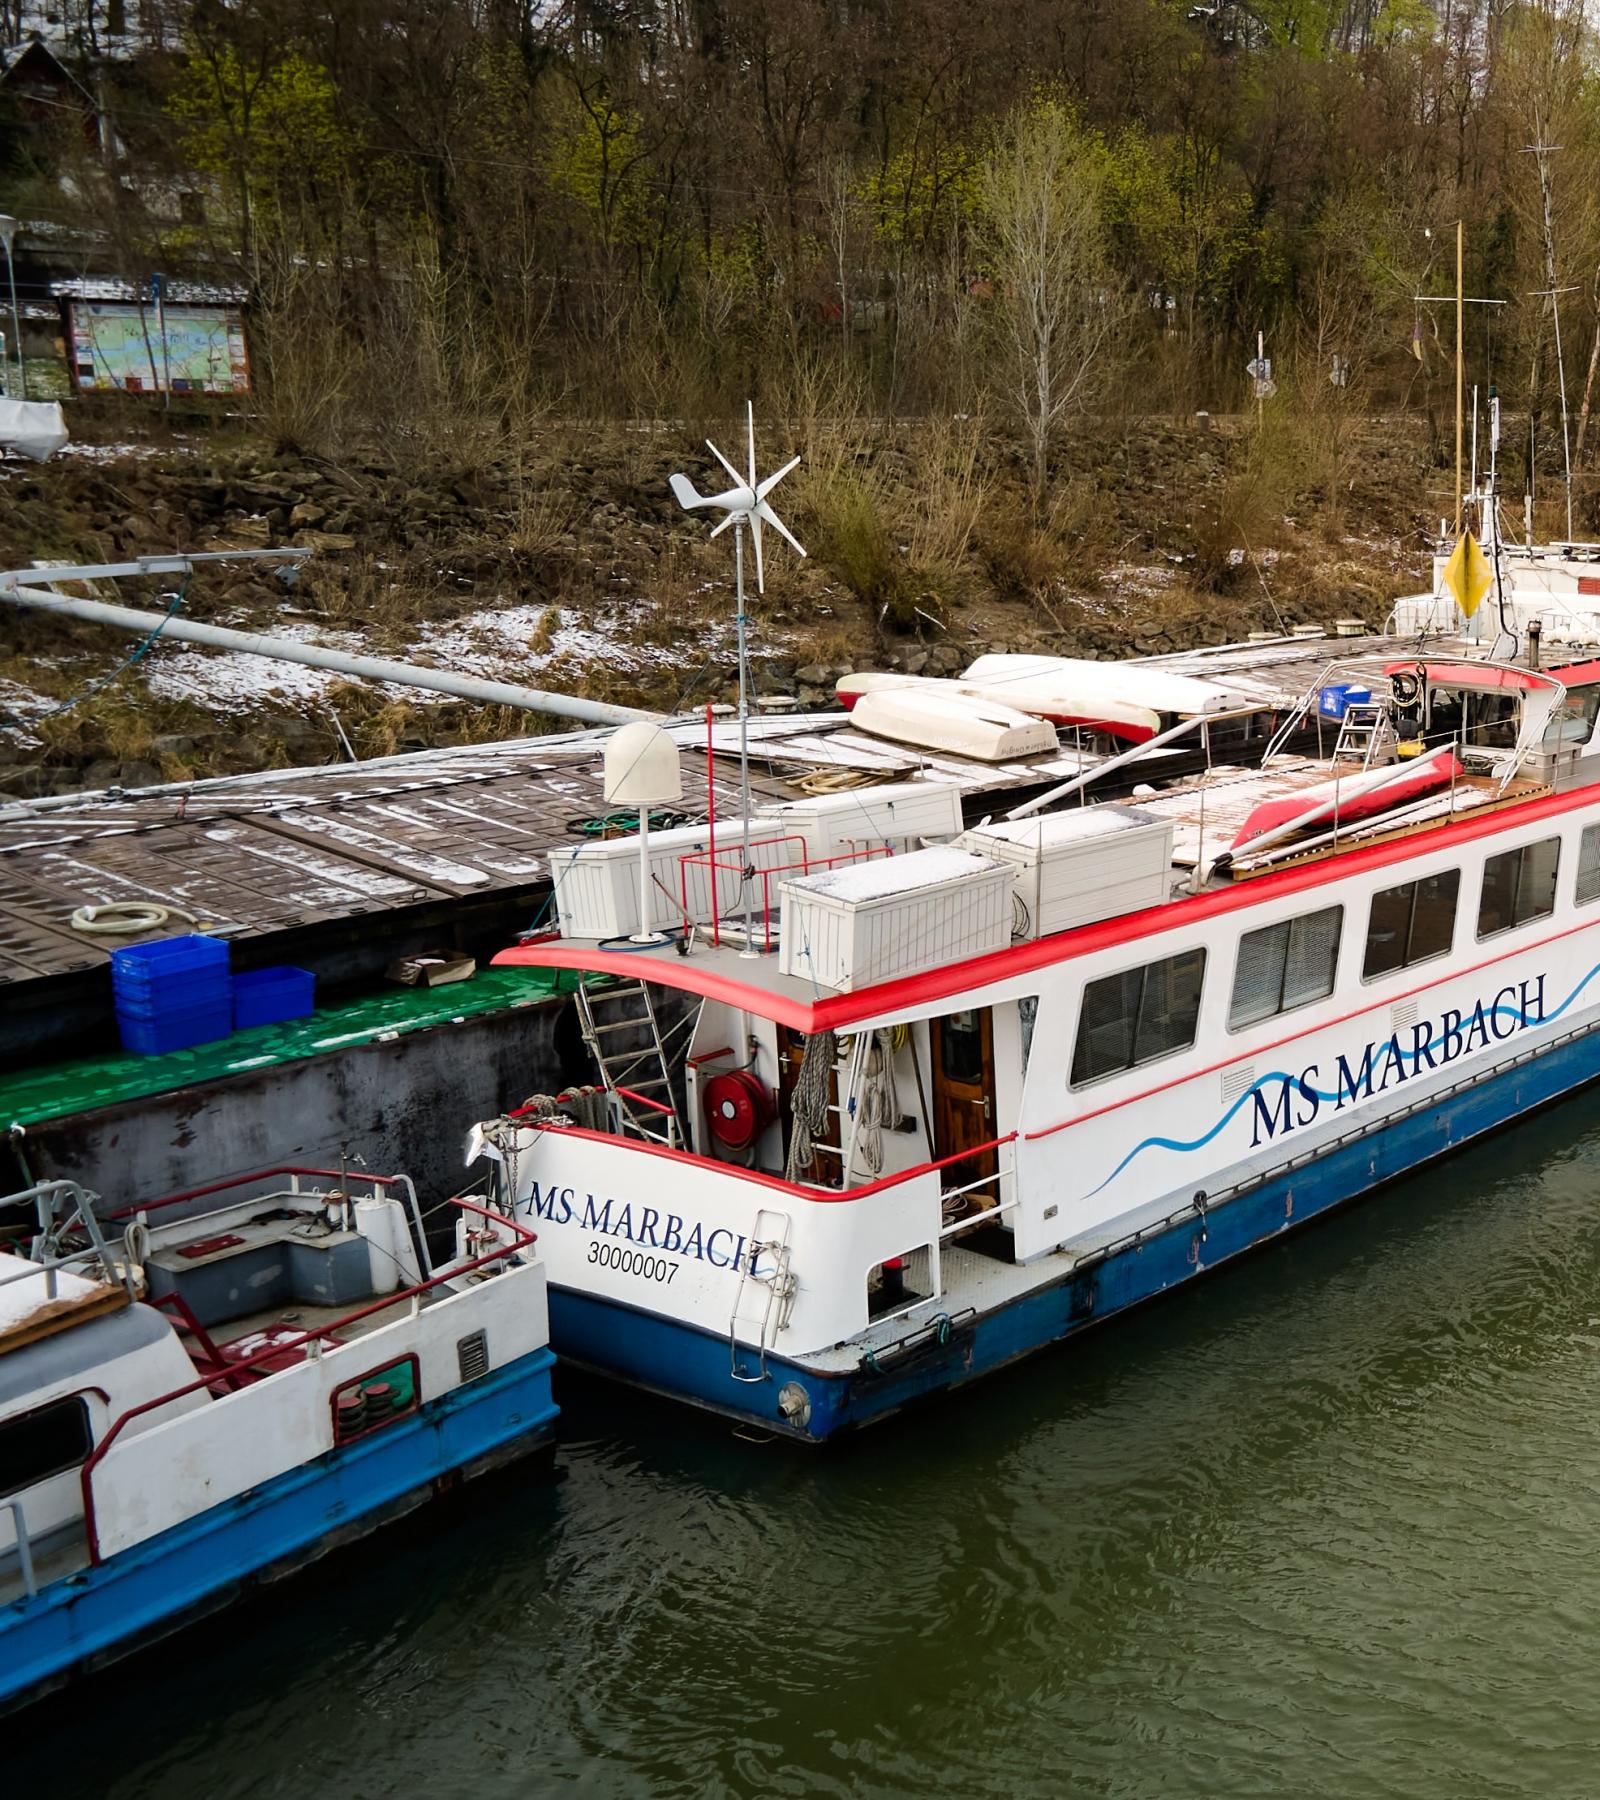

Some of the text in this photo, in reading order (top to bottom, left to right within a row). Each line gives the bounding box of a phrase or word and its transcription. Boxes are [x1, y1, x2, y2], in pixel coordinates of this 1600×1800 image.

[1248, 973, 1546, 1148] MS MARBACH
[526, 1181, 762, 1276] MS MARBACH
[587, 1241, 679, 1284] 30000007
